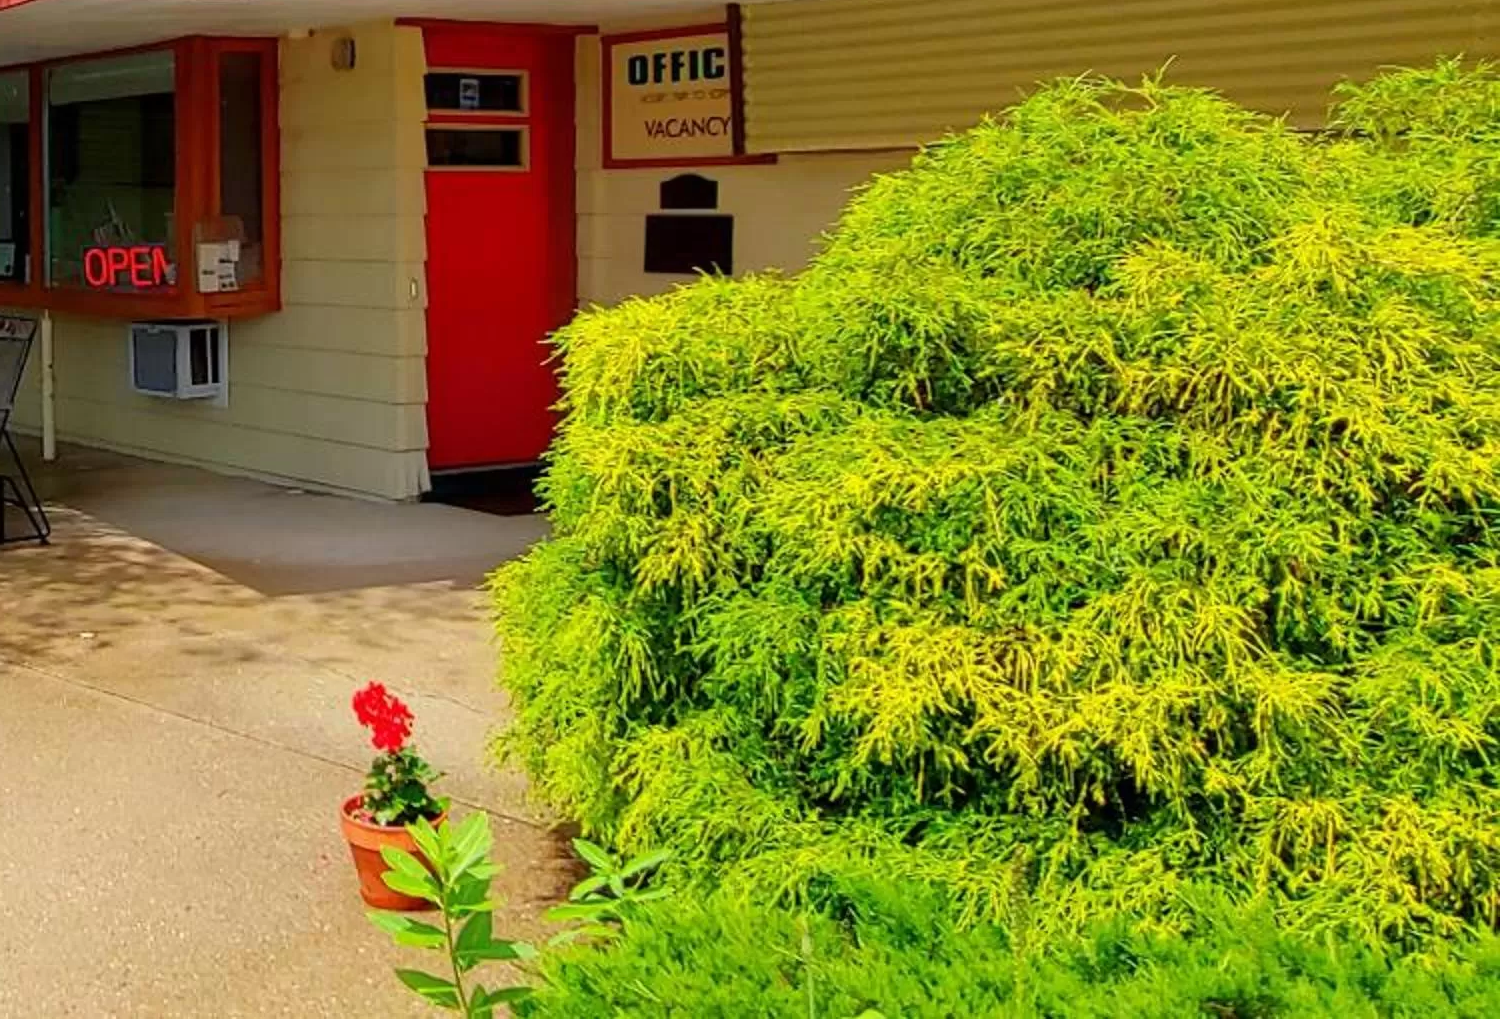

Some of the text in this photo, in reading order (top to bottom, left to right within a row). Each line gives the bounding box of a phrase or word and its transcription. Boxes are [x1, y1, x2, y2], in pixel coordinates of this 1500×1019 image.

[627, 48, 725, 85] OFFIC
[644, 116, 731, 139] VACANCY
[84, 246, 173, 287] OPEN
